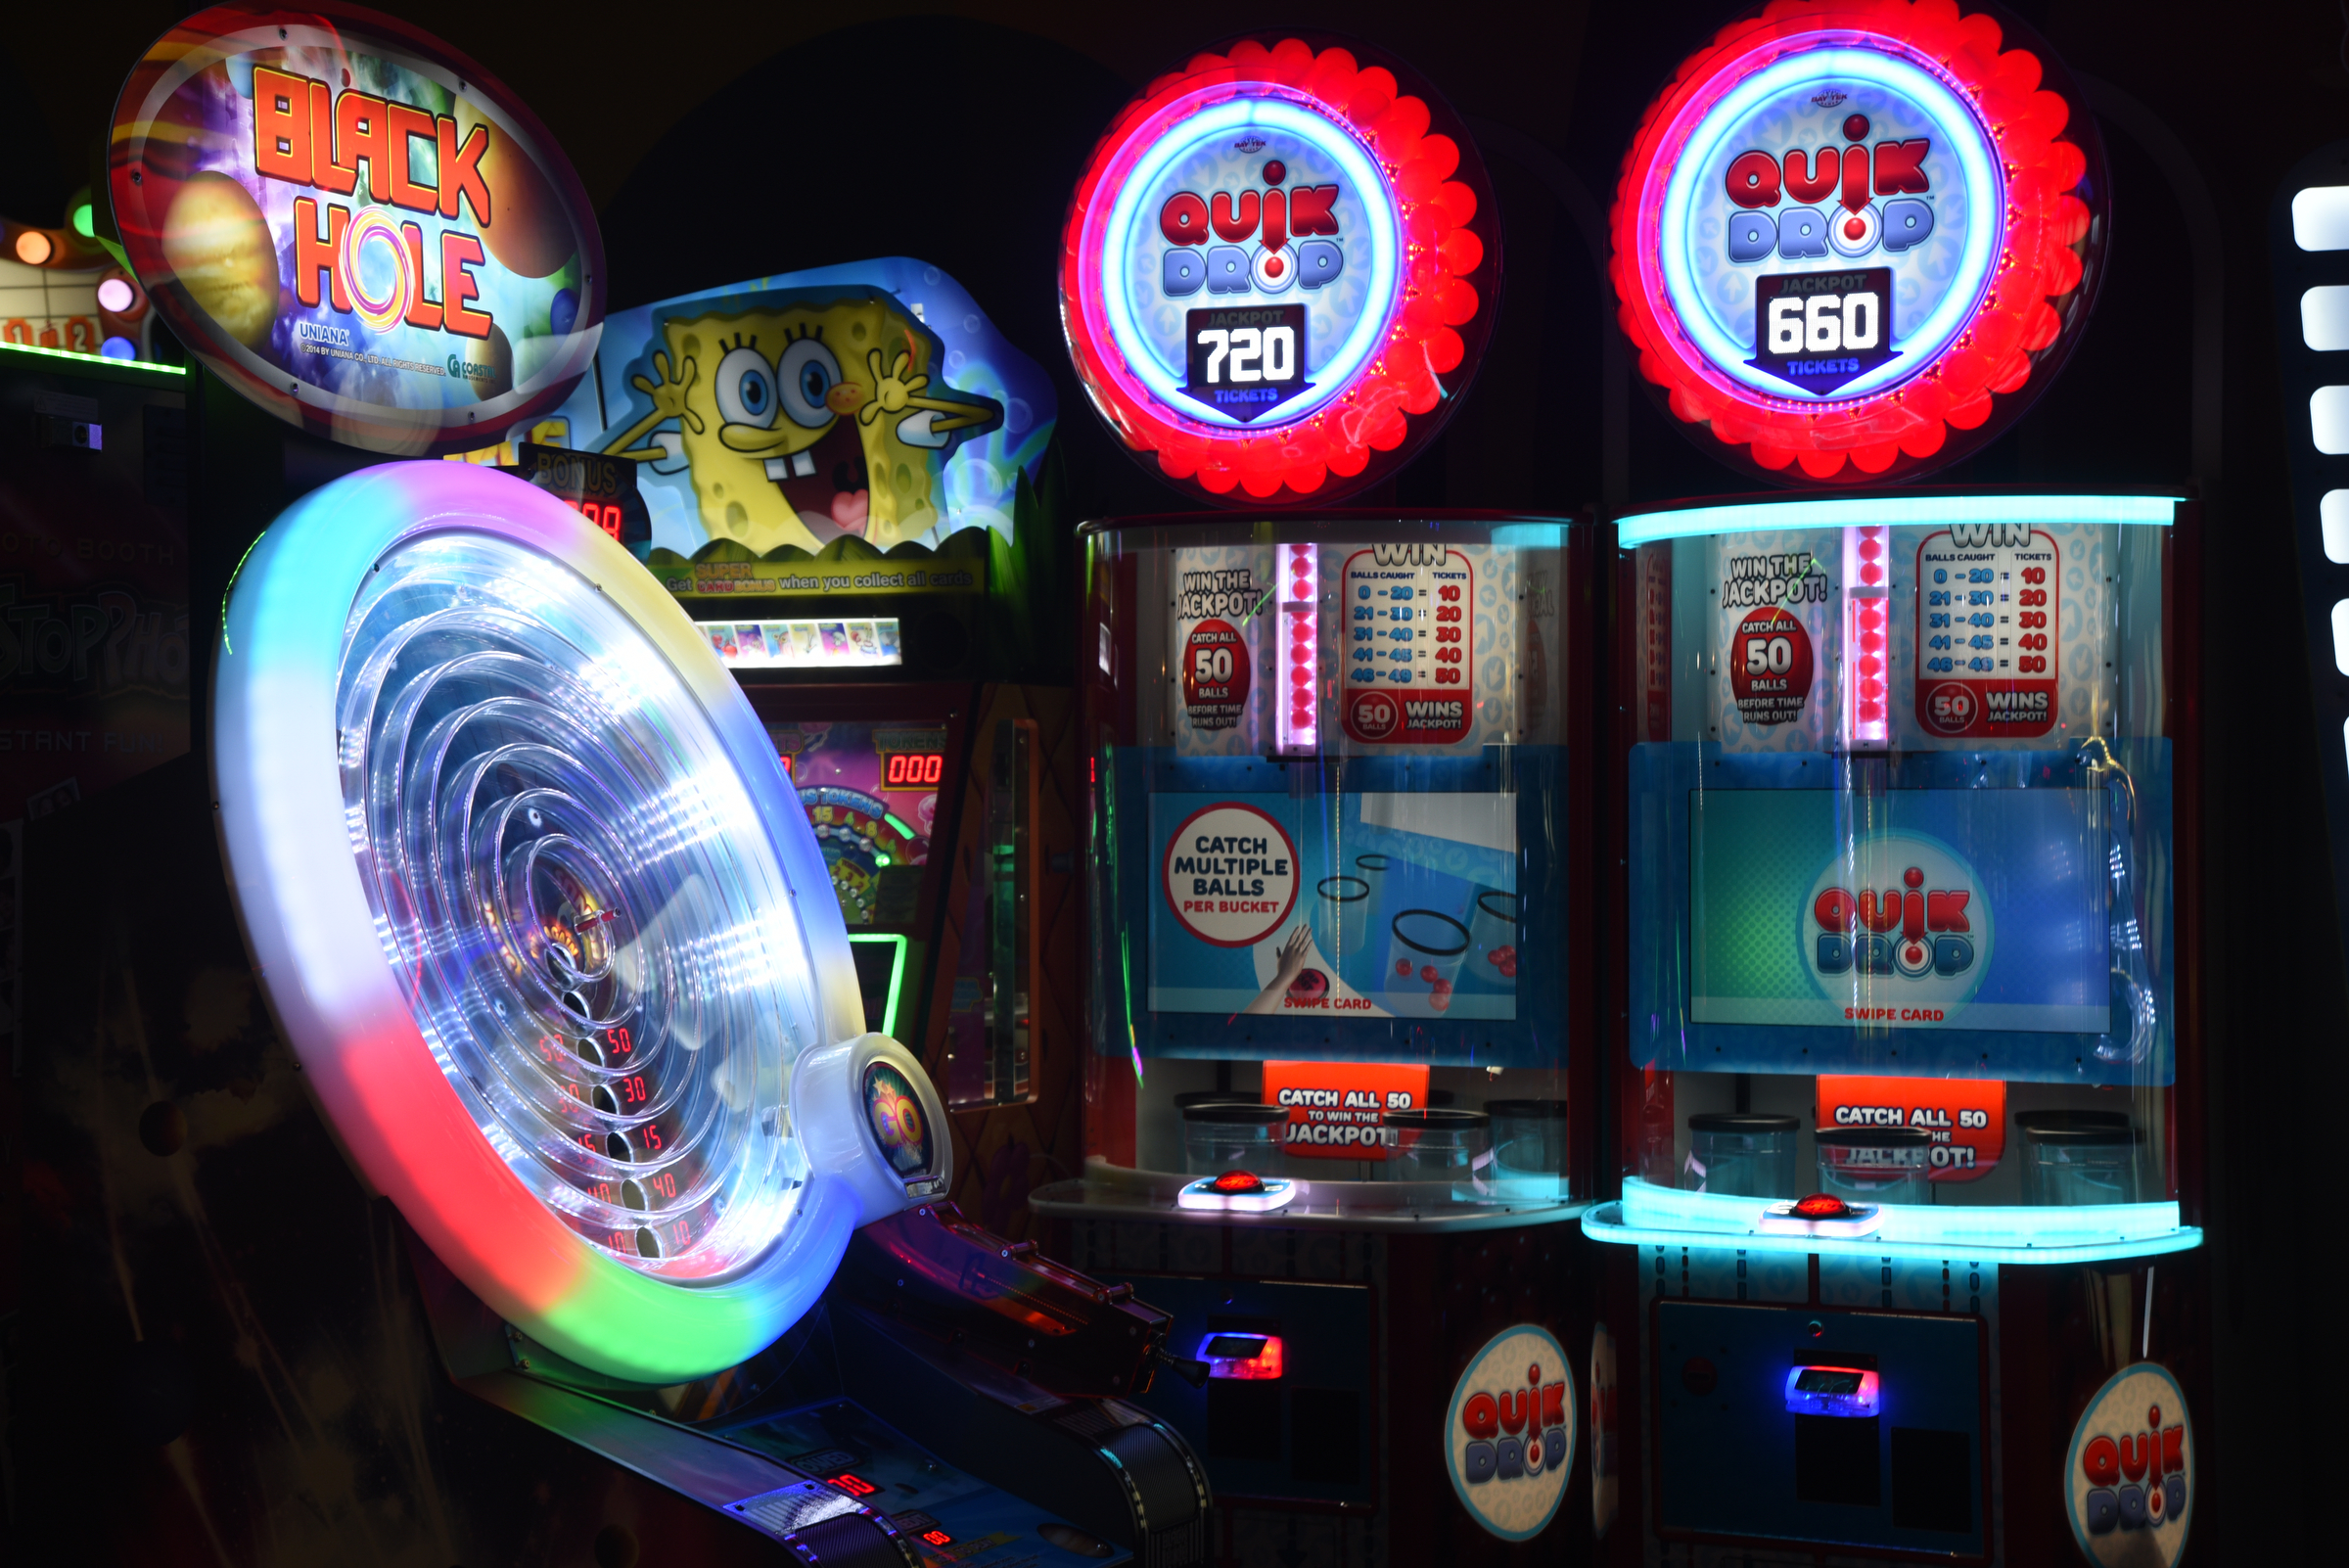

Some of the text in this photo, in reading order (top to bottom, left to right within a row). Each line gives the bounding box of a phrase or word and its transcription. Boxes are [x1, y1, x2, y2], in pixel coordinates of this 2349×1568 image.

[253, 65, 490, 228] BLACK
[1728, 199, 1934, 264] DROP
[294, 196, 492, 341] HOLE
[1163, 240, 1344, 297] DROP
[1780, 274, 1866, 294] JACKPOT
[1209, 310, 1283, 326] JACKPOT
[1769, 292, 1878, 354] 660
[321, 346, 330, 355] BY
[331, 348, 352, 360] UNIANA
[381, 357, 392, 367] ALL
[392, 358, 414, 371] RIGHTS
[1197, 326, 1295, 383] 720
[1787, 358, 1859, 375] TICKETS
[1215, 389, 1277, 403] TICKETS
[538, 452, 617, 494] BONUS
[1949, 523, 2031, 548] WIN
[77, 538, 174, 566] BOOTH
[1372, 544, 1447, 567] WIN
[695, 562, 753, 579] SUPER
[1730, 553, 1813, 579] WIN THE
[667, 576, 692, 591] Get
[779, 574, 819, 589] when
[822, 576, 851, 592] you
[853, 573, 903, 587] collect
[907, 571, 926, 585] all
[930, 570, 972, 585] cards
[1183, 569, 1251, 592] WIN THE
[1722, 574, 1827, 608] JACKPOT!
[1177, 589, 1263, 620] JACKPOT!
[1192, 632, 1236, 644] CATCH ALL
[1742, 621, 1797, 634] CATCH ALL
[1194, 648, 1233, 683] 50
[1746, 636, 1792, 675] 50
[1198, 687, 1228, 699] BALLS
[1751, 678, 1787, 692] BALLS
[1187, 704, 1242, 715] BEFORE TIME
[1405, 701, 1463, 718] WINS
[1737, 697, 1804, 711] BEFORE TIME
[1934, 696, 1969, 716] 50
[1986, 691, 2049, 711] WINS
[1192, 716, 1236, 728] RUNS OUT!
[1358, 705, 1391, 723] 50
[1405, 718, 1462, 730] JACKPOT!
[1743, 711, 1797, 723] RUNS OUT!
[1987, 711, 2048, 723] JACKPOT!
[889, 755, 943, 783] 000
[820, 788, 884, 819] TOKENS
[812, 806, 833, 823] 15
[865, 820, 878, 839] 8
[1196, 836, 1267, 855] CATCH
[1174, 856, 1288, 876] MULTIPLE
[1193, 879, 1265, 898] BALLS
[1184, 900, 1279, 914] PER BUCKET
[1818, 933, 1974, 979] DROP
[1284, 996, 1371, 1010] SWIPE CARD
[1844, 1007, 1944, 1022] SWIPE CARD
[607, 1028, 631, 1053] 50
[623, 1077, 646, 1102] 30
[1278, 1088, 1411, 1109] CATCH ALL 50
[873, 1095, 924, 1148] GO
[1308, 1110, 1378, 1123] TO WIN THE
[1835, 1106, 1987, 1128] CATCH ALL 50
[643, 1126, 662, 1150] 15
[1931, 1130, 1951, 1142] HE
[653, 1174, 676, 1198] 40
[673, 1221, 691, 1245] 10
[1466, 1427, 1567, 1484] DROP
[2087, 1474, 2187, 1535] DROP
